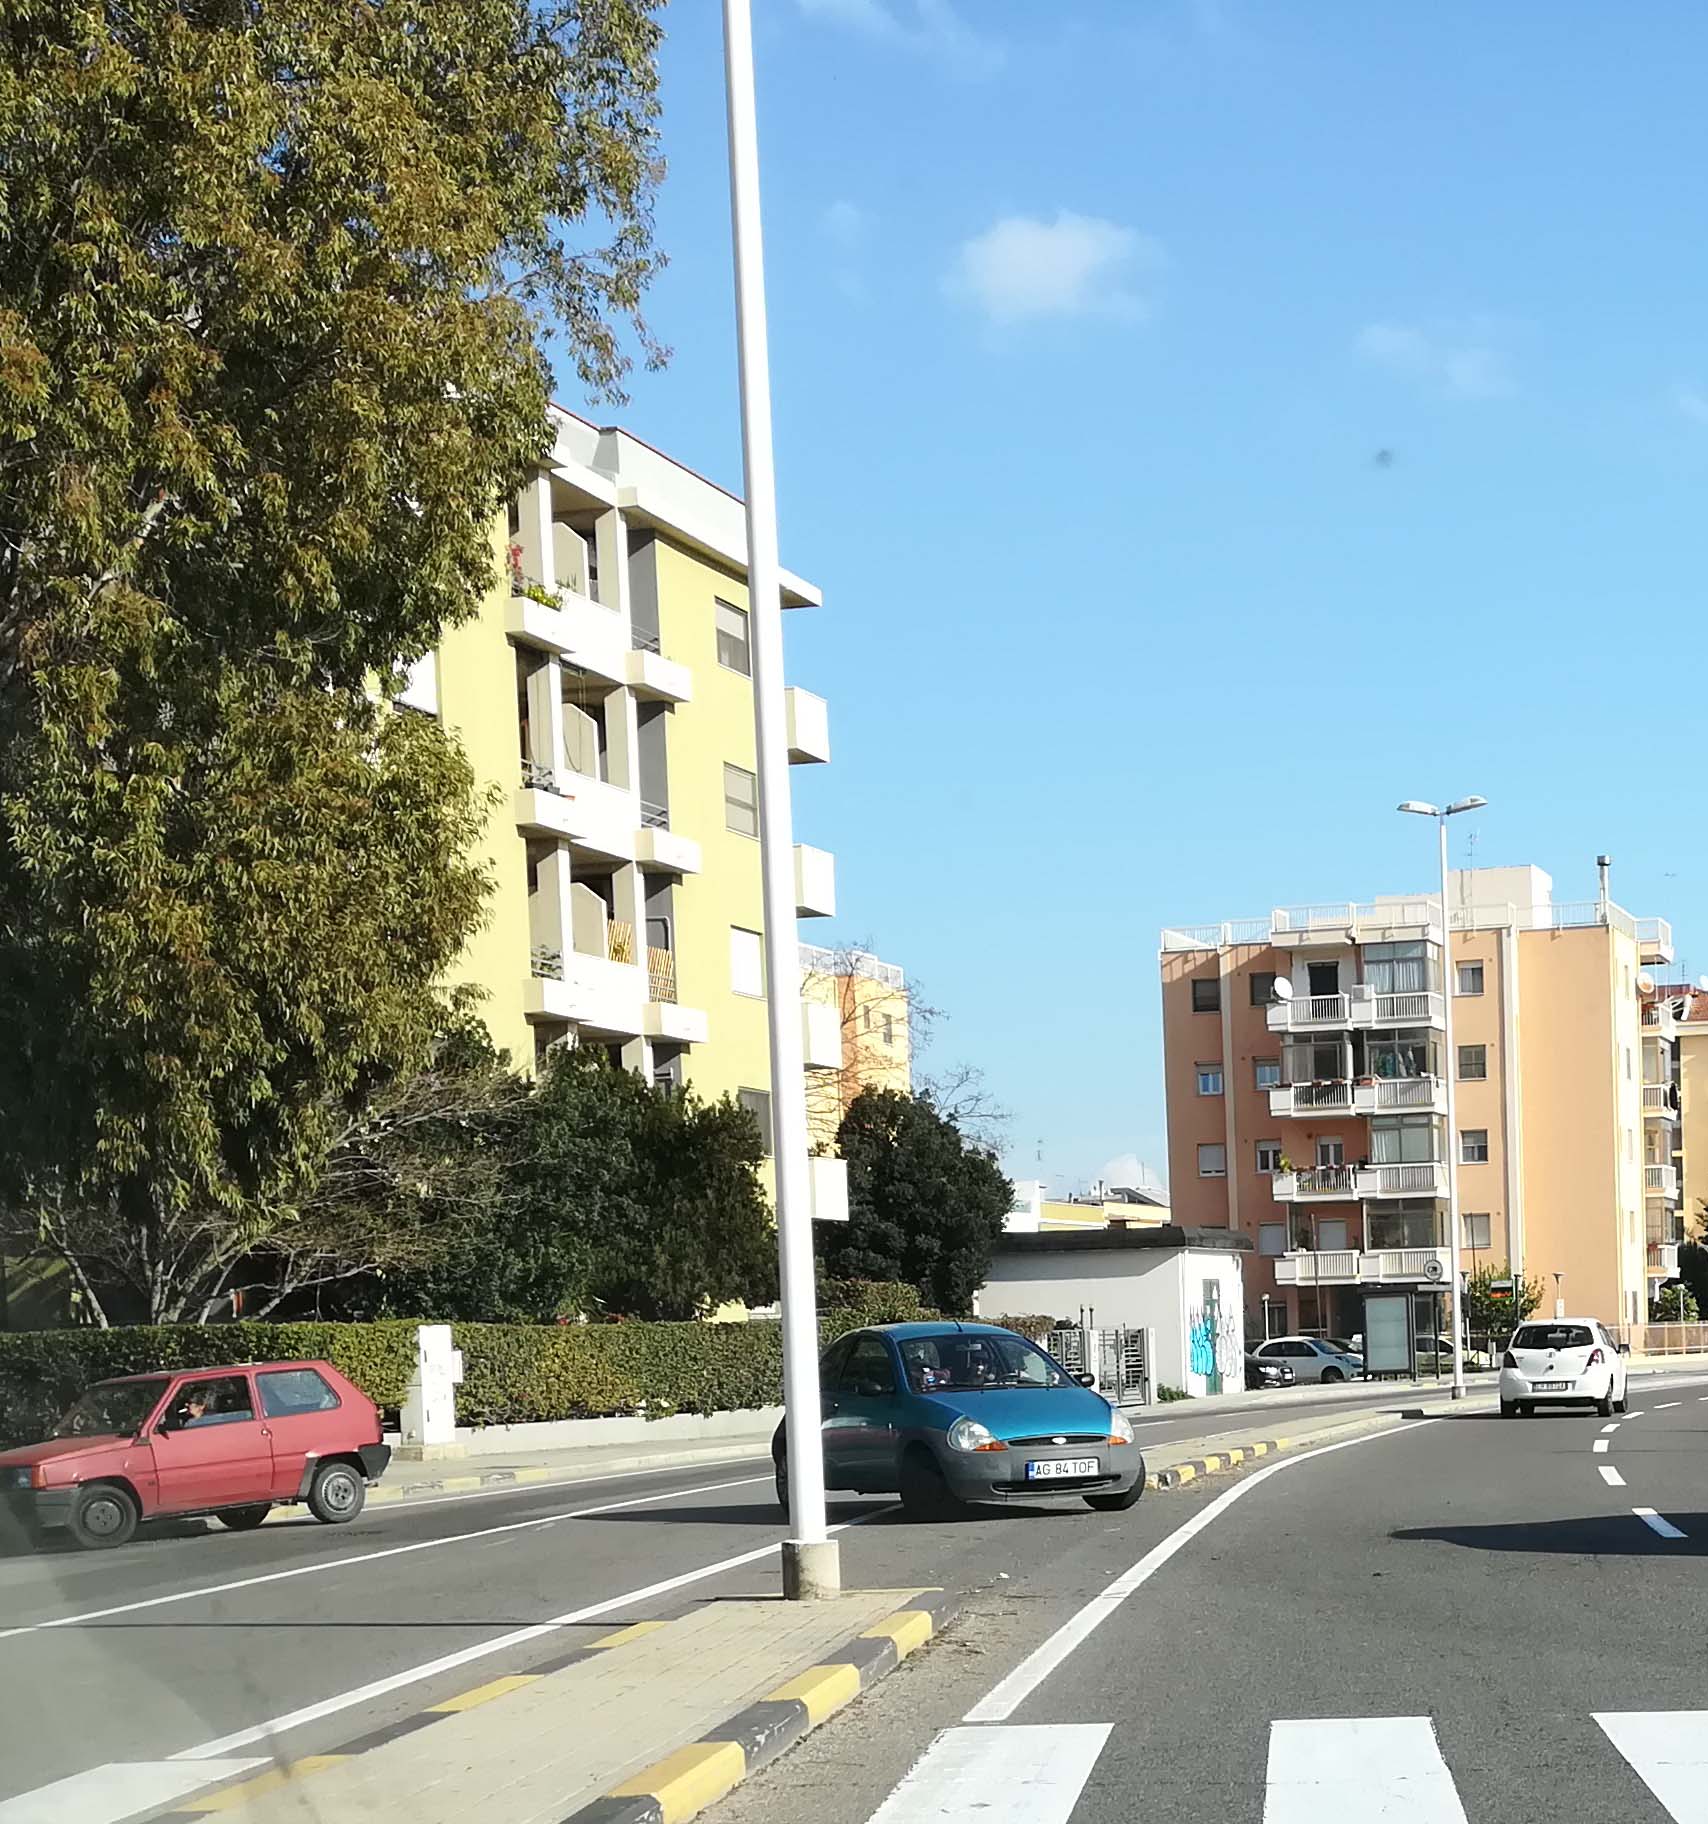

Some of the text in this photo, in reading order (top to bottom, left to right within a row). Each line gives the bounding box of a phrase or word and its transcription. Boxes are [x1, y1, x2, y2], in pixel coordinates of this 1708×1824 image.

[1035, 1460, 1096, 1476] AG 84 TOF
